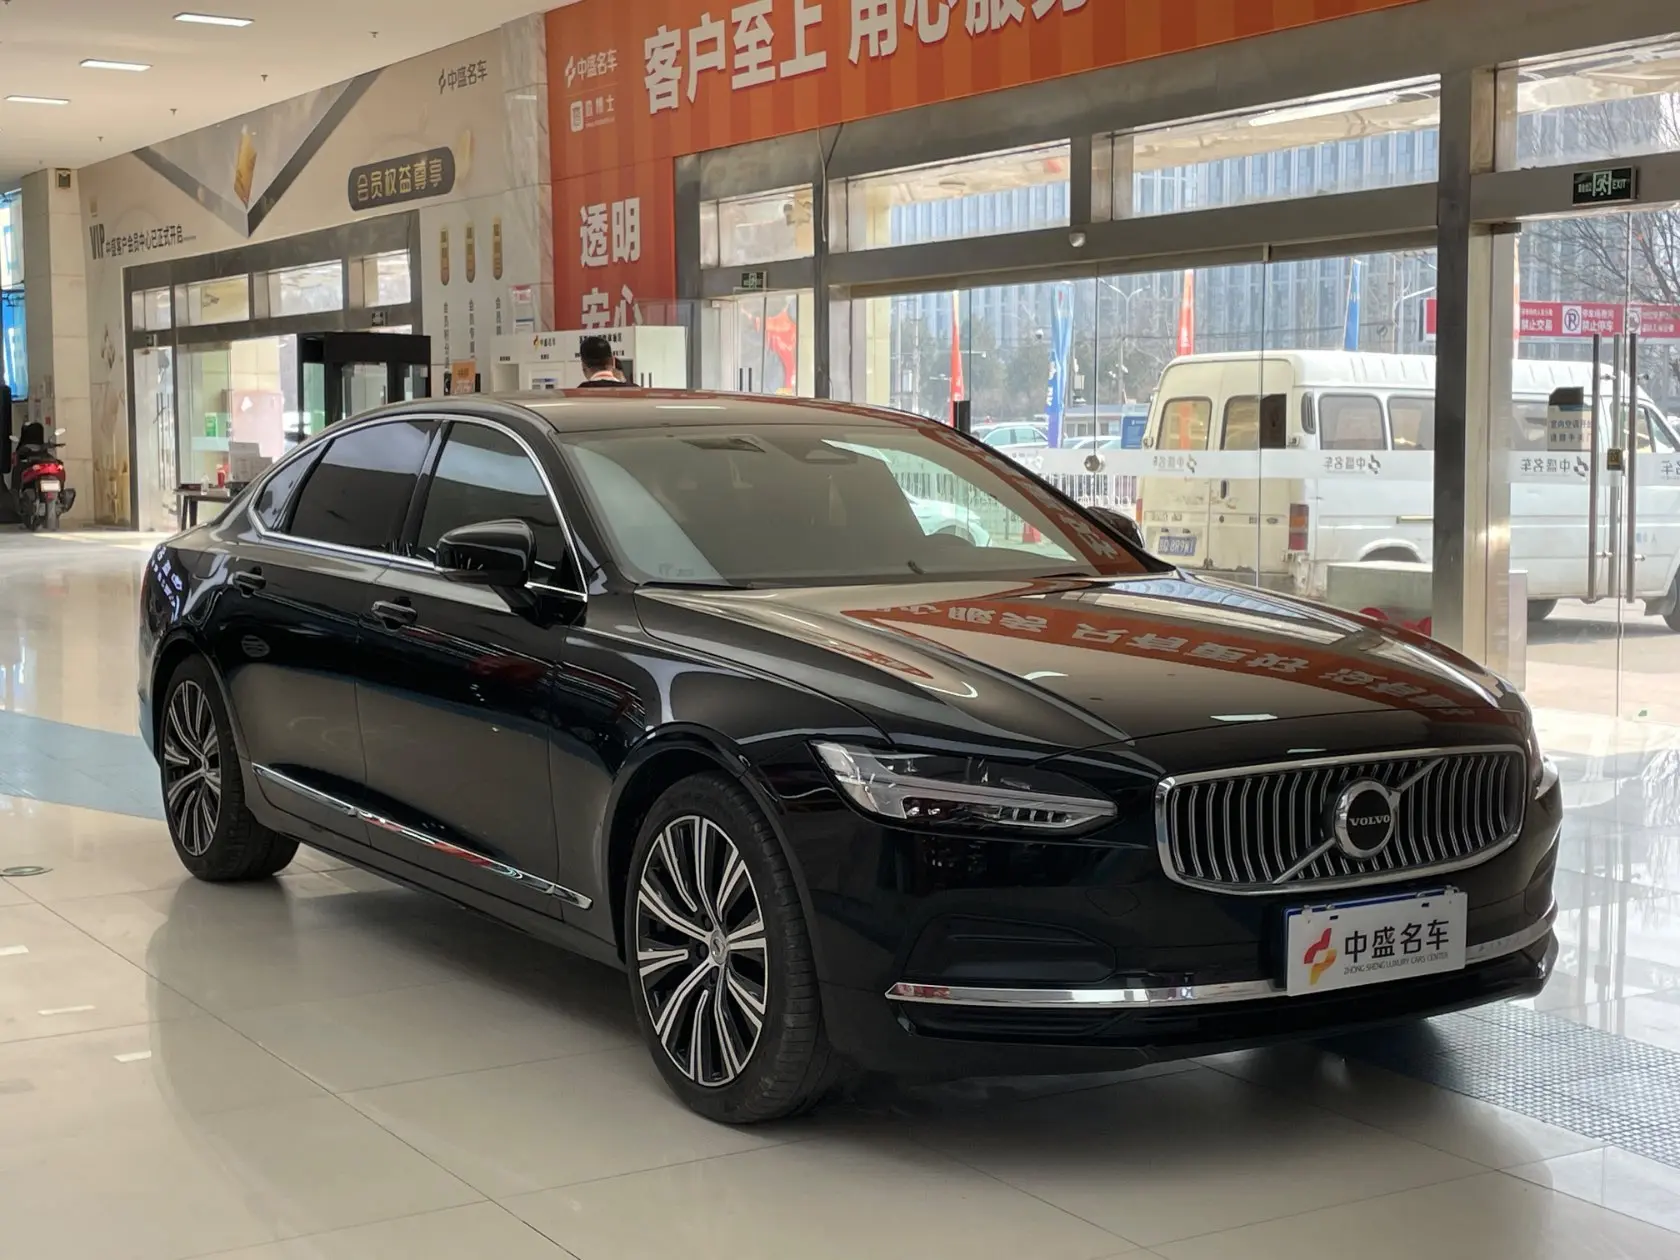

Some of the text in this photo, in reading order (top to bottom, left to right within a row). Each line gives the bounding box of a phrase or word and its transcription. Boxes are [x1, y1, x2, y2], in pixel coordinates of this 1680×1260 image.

[447, 60, 488, 91] 中盛名车
[577, 49, 618, 80] 中盛名车
[644, 0, 1088, 115] 客户至上 用心
[357, 158, 443, 202] 会员权益尊享
[1612, 178, 1627, 189] EXIT
[89, 224, 105, 260] VIP
[580, 197, 640, 268] 透明
[1350, 814, 1391, 826] VOLVO
[1344, 919, 1450, 963] 中盛名车
